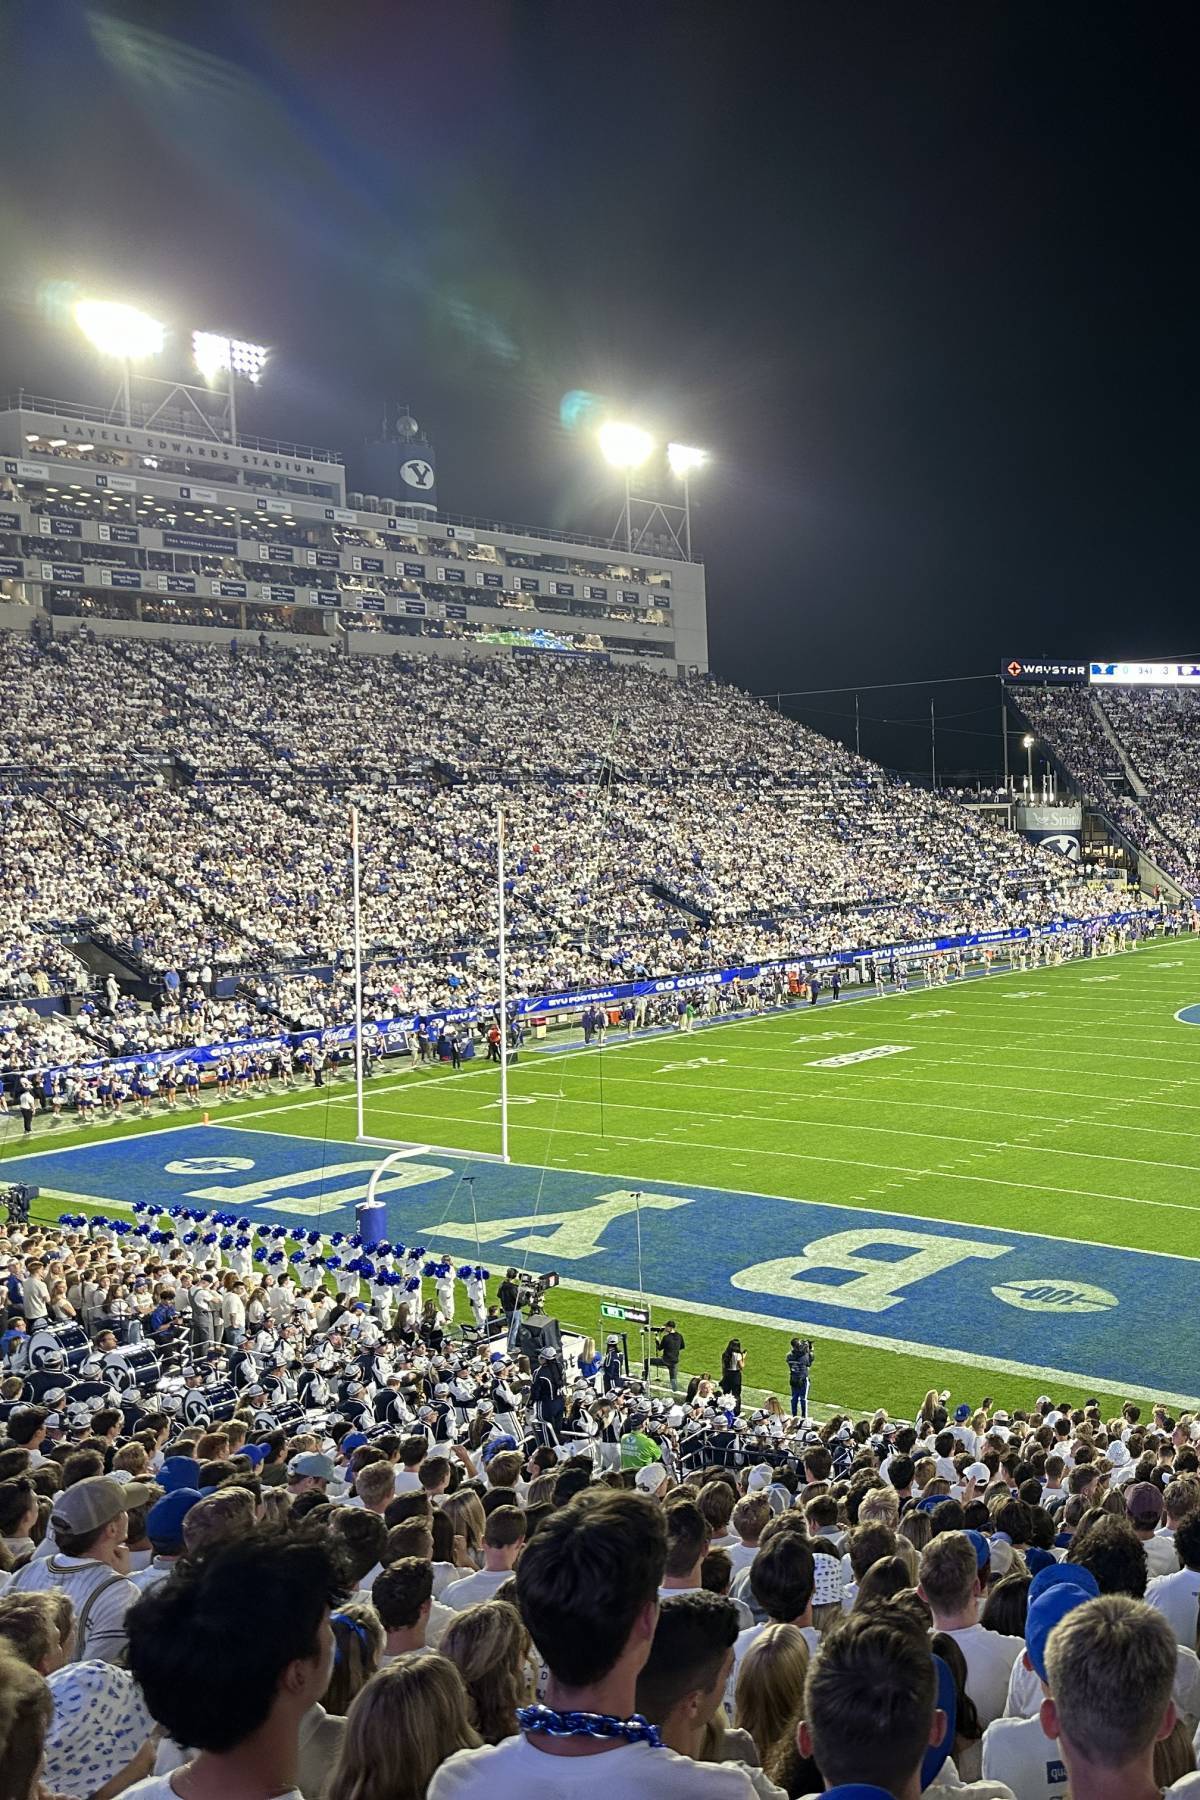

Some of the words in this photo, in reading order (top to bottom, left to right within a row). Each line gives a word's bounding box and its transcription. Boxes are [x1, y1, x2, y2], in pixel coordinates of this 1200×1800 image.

[148, 439, 229, 460] EDWARDS
[242, 455, 315, 474] STADIUM
[56, 521, 74, 529] Citrus
[112, 527, 137, 536] Freedom
[1022, 664, 1086, 675] WAYSTAR
[873, 950, 891, 959] BYU
[893, 943, 937, 955] COUGARS
[655, 982, 674, 992] GO
[676, 974, 722, 988] COUGS
[548, 998, 568, 1007] BYU
[568, 992, 613, 1004] FOOTBALL
[387, 1019, 415, 1032] Coca-Cola
[321, 1026, 351, 1042] Coca-Cola
